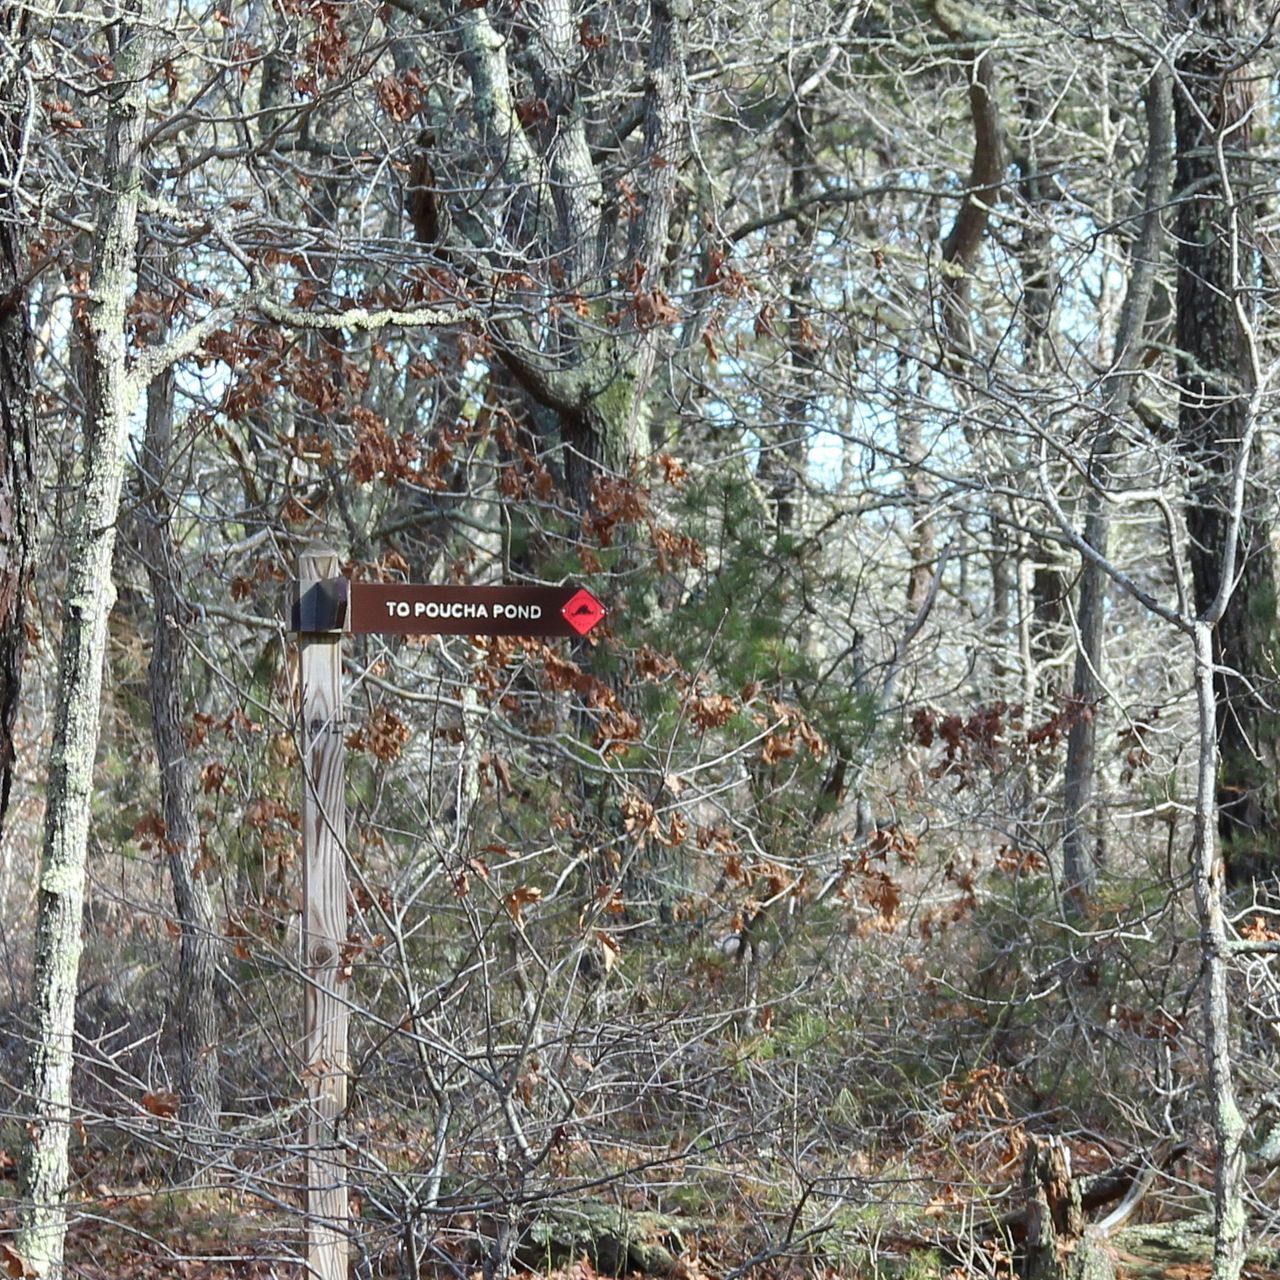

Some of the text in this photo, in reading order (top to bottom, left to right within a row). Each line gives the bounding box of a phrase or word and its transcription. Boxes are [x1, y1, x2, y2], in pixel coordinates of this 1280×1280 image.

[386, 602, 542, 619] TO POUCHA POND
